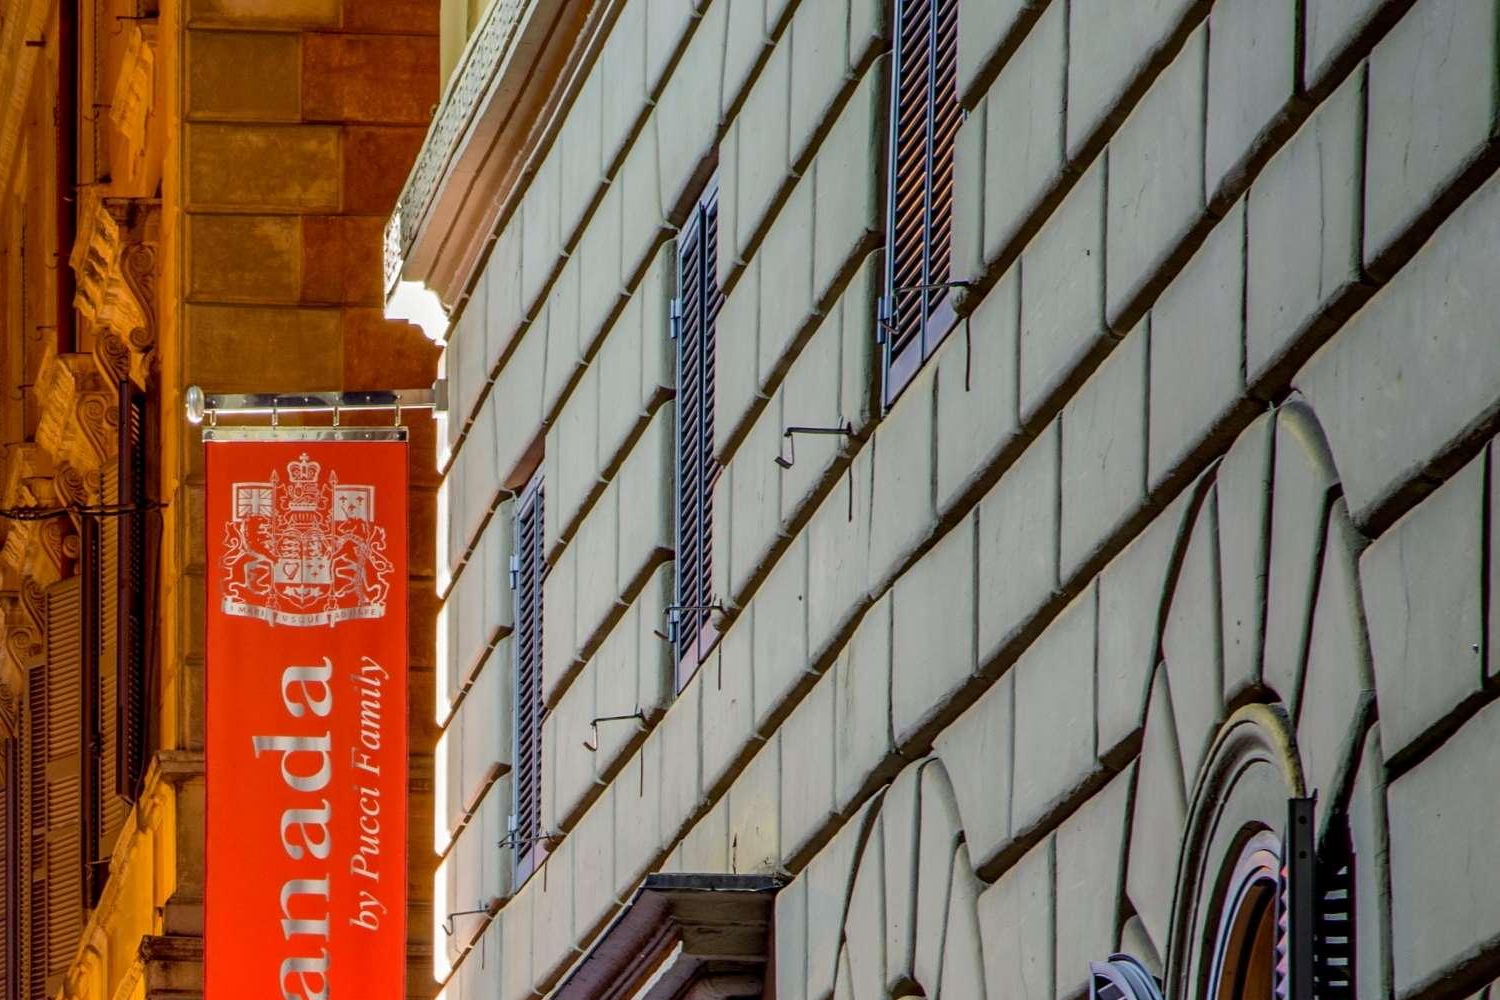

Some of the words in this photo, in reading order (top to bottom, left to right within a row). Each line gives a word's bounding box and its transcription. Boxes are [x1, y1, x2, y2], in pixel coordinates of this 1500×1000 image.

[350, 656, 389, 777] Family
[350, 786, 381, 882] Pucci
[350, 892, 388, 931] by
